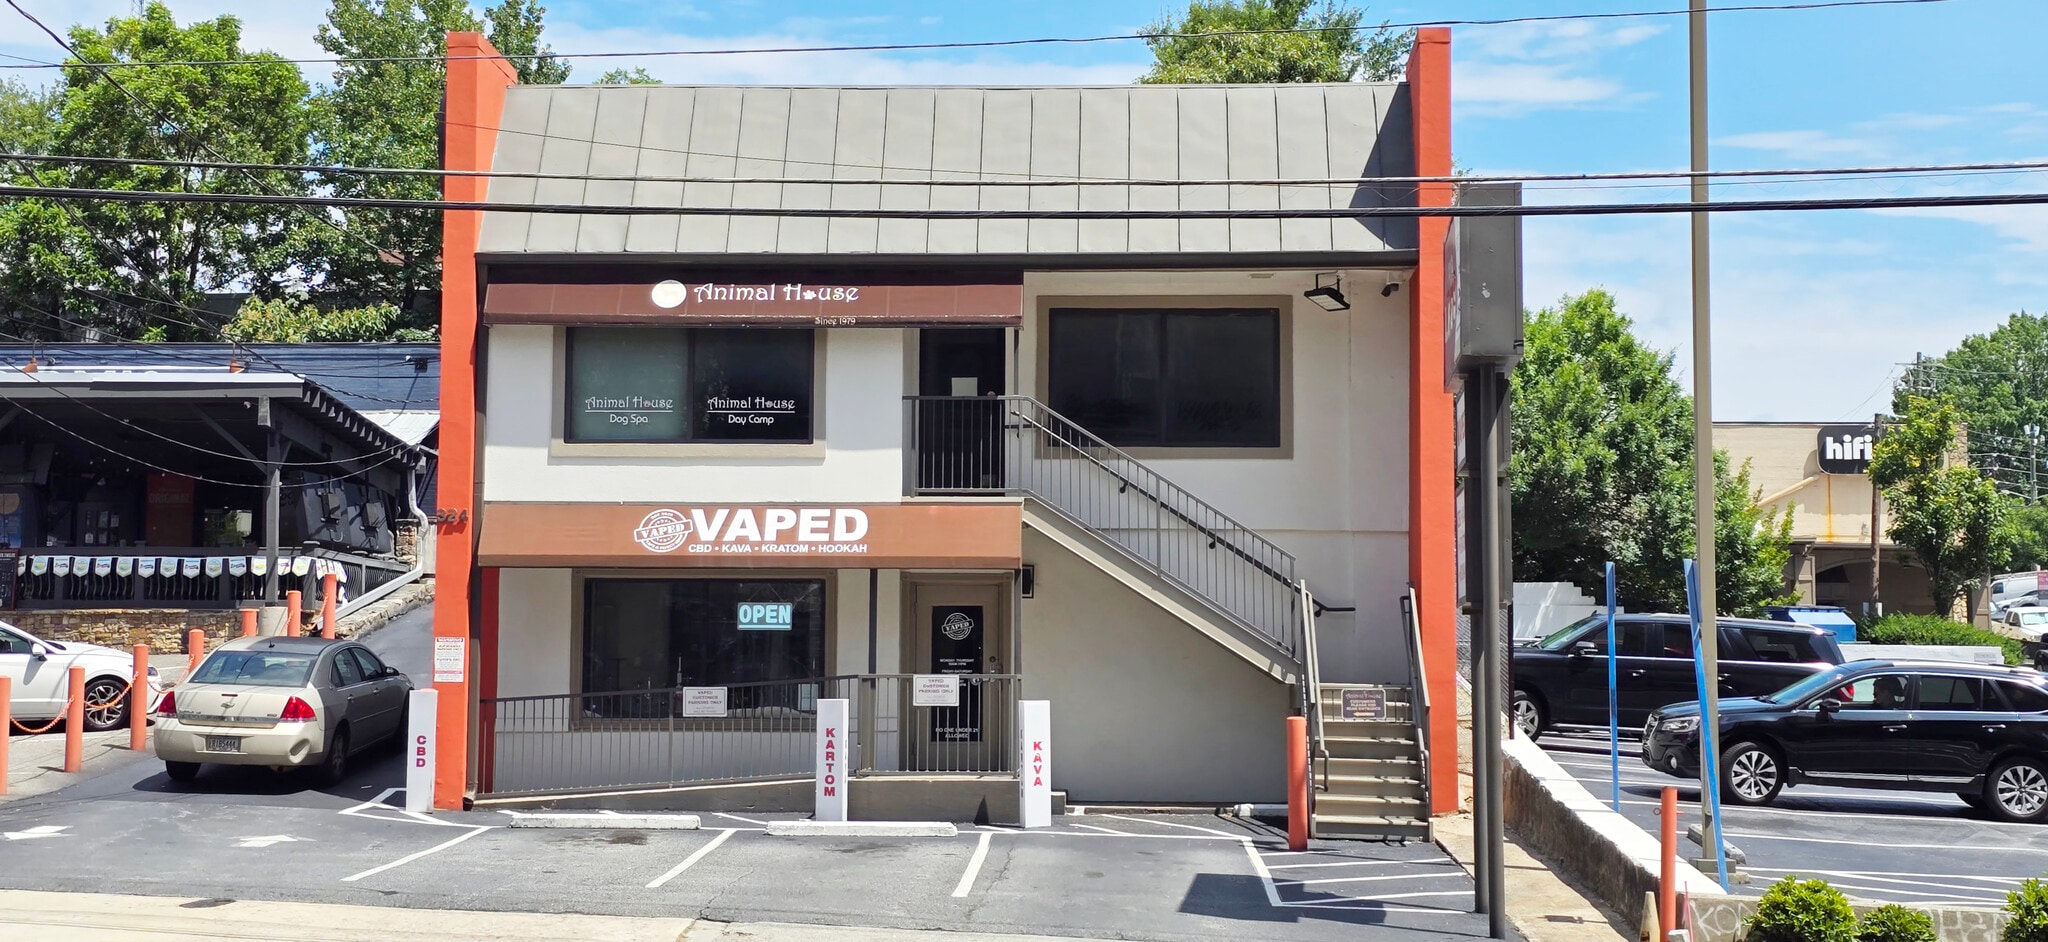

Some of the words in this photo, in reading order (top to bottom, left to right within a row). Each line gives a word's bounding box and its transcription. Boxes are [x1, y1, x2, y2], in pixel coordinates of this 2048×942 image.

[694, 283, 775, 303] Animal
[815, 316, 837, 326] Since
[839, 317, 856, 325] 1979
[585, 396, 629, 410] Animal
[707, 396, 751, 410] Animal
[609, 414, 629, 425] Dog
[630, 414, 649, 425] Spa
[728, 414, 747, 425] Day
[748, 414, 775, 425] Camp
[1826, 434, 1873, 460] hifi
[641, 524, 685, 538] VAPED
[690, 508, 869, 541] VAPED
[688, 544, 712, 553] CBD
[721, 544, 752, 553] KAVA
[761, 544, 809, 553] KRATOM
[818, 544, 868, 553] HOOKAH
[739, 604, 791, 623] OPEN
[415, 735, 427, 767] CBD
[824, 727, 836, 797] KARTOM
[1033, 741, 1043, 786] KAVA
